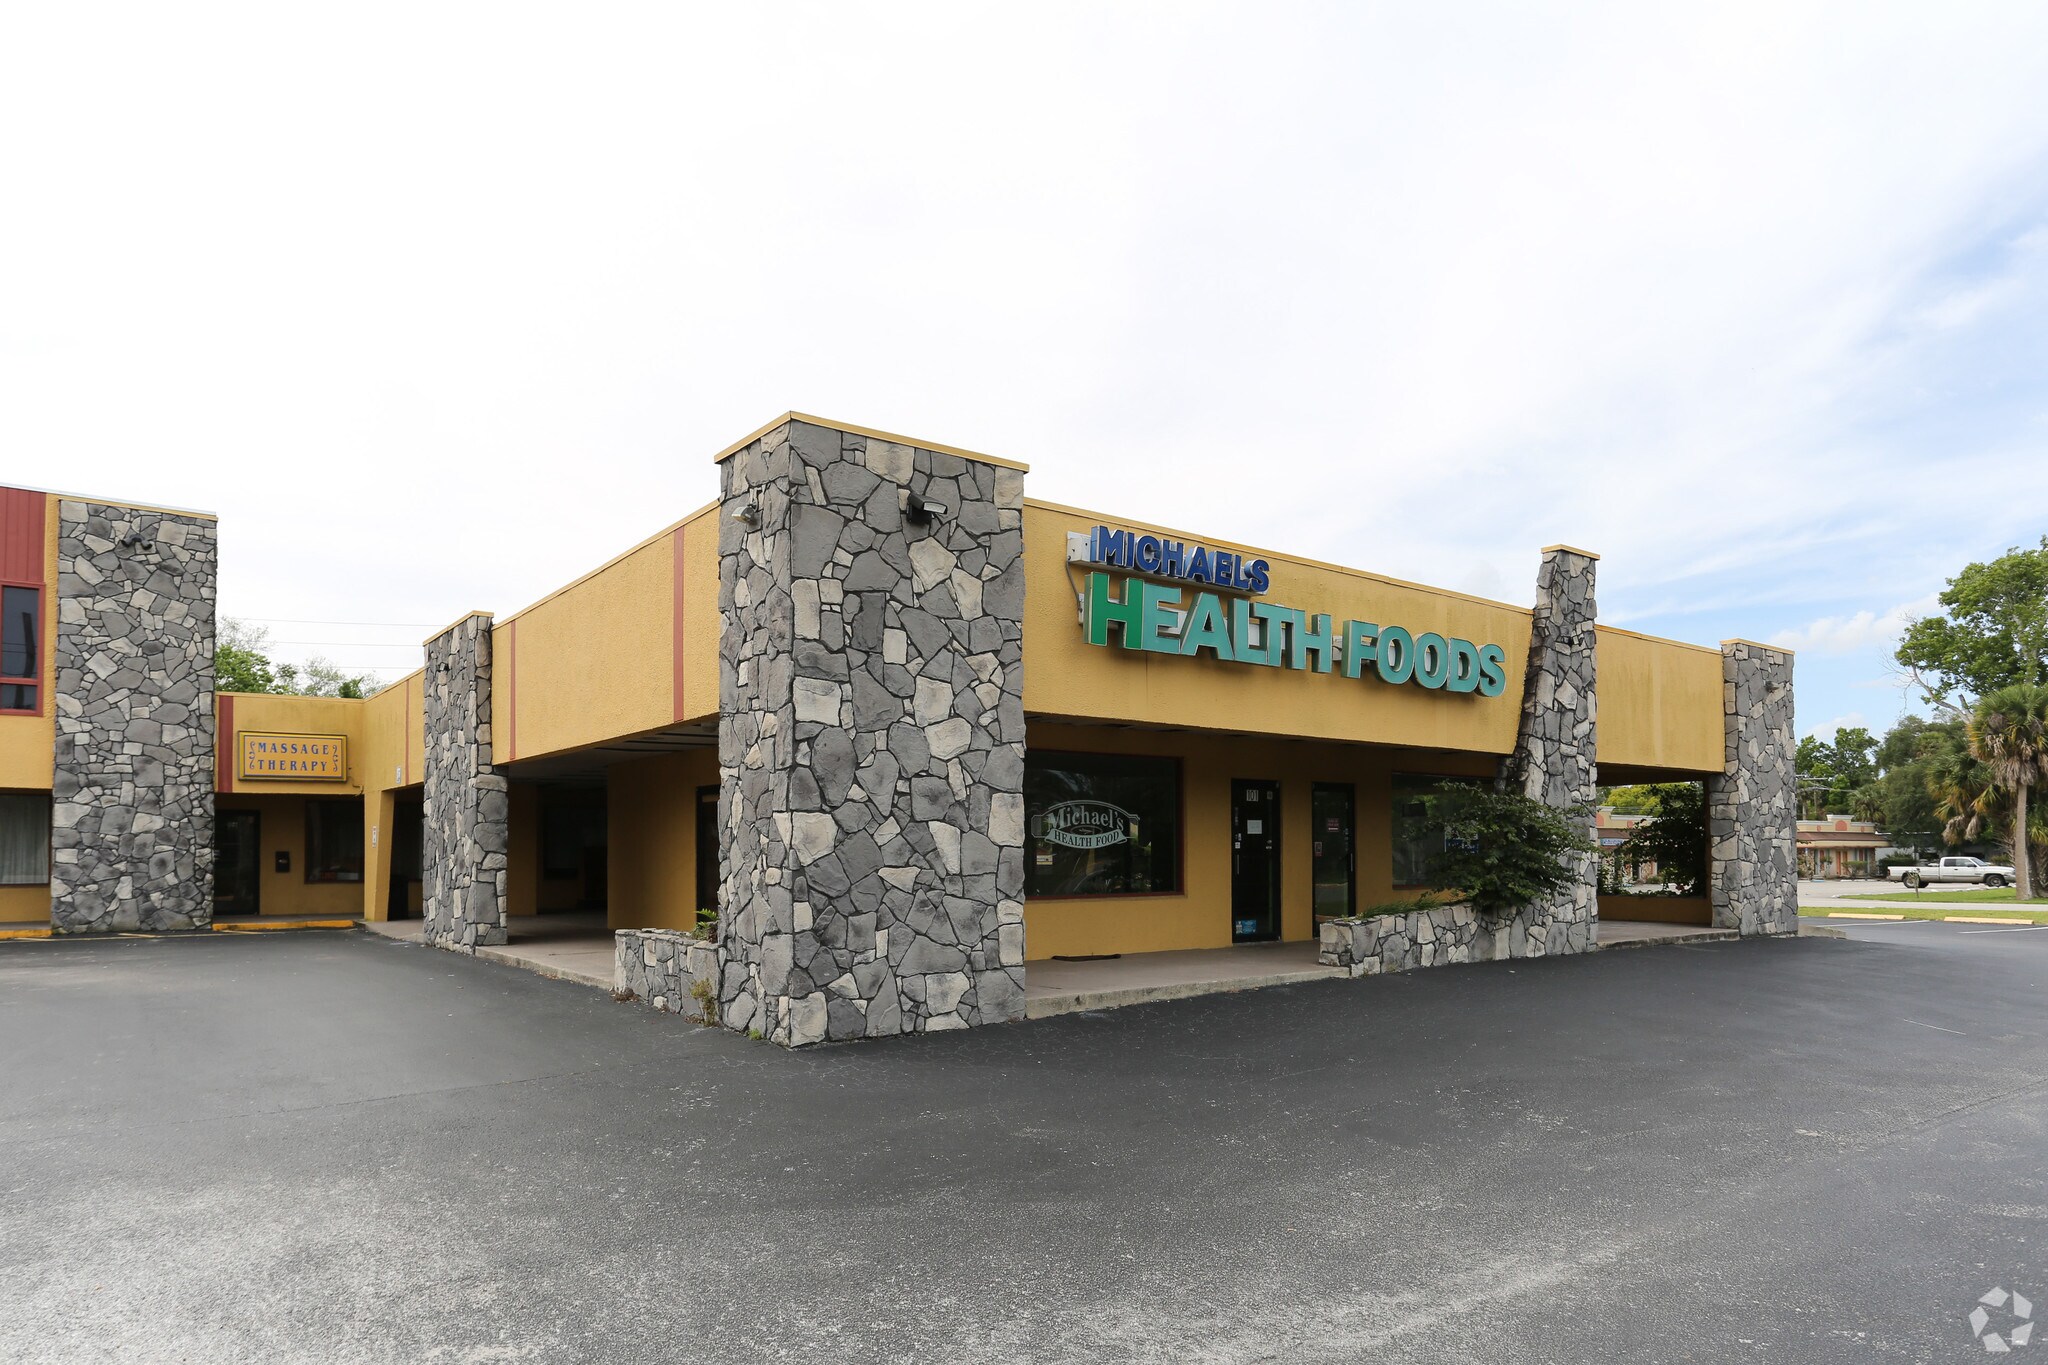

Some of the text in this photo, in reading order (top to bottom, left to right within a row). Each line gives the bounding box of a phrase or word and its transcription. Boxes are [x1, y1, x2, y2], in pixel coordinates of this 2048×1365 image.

[1091, 525, 1270, 593] MICHAELS
[1084, 572, 1506, 697] HEALTH FOODS
[258, 742, 329, 755] MASSAGE
[258, 760, 328, 771] THERAPY
[1047, 805, 1124, 832] Michael's
[1054, 831, 1119, 847] HEALTH FOOD
